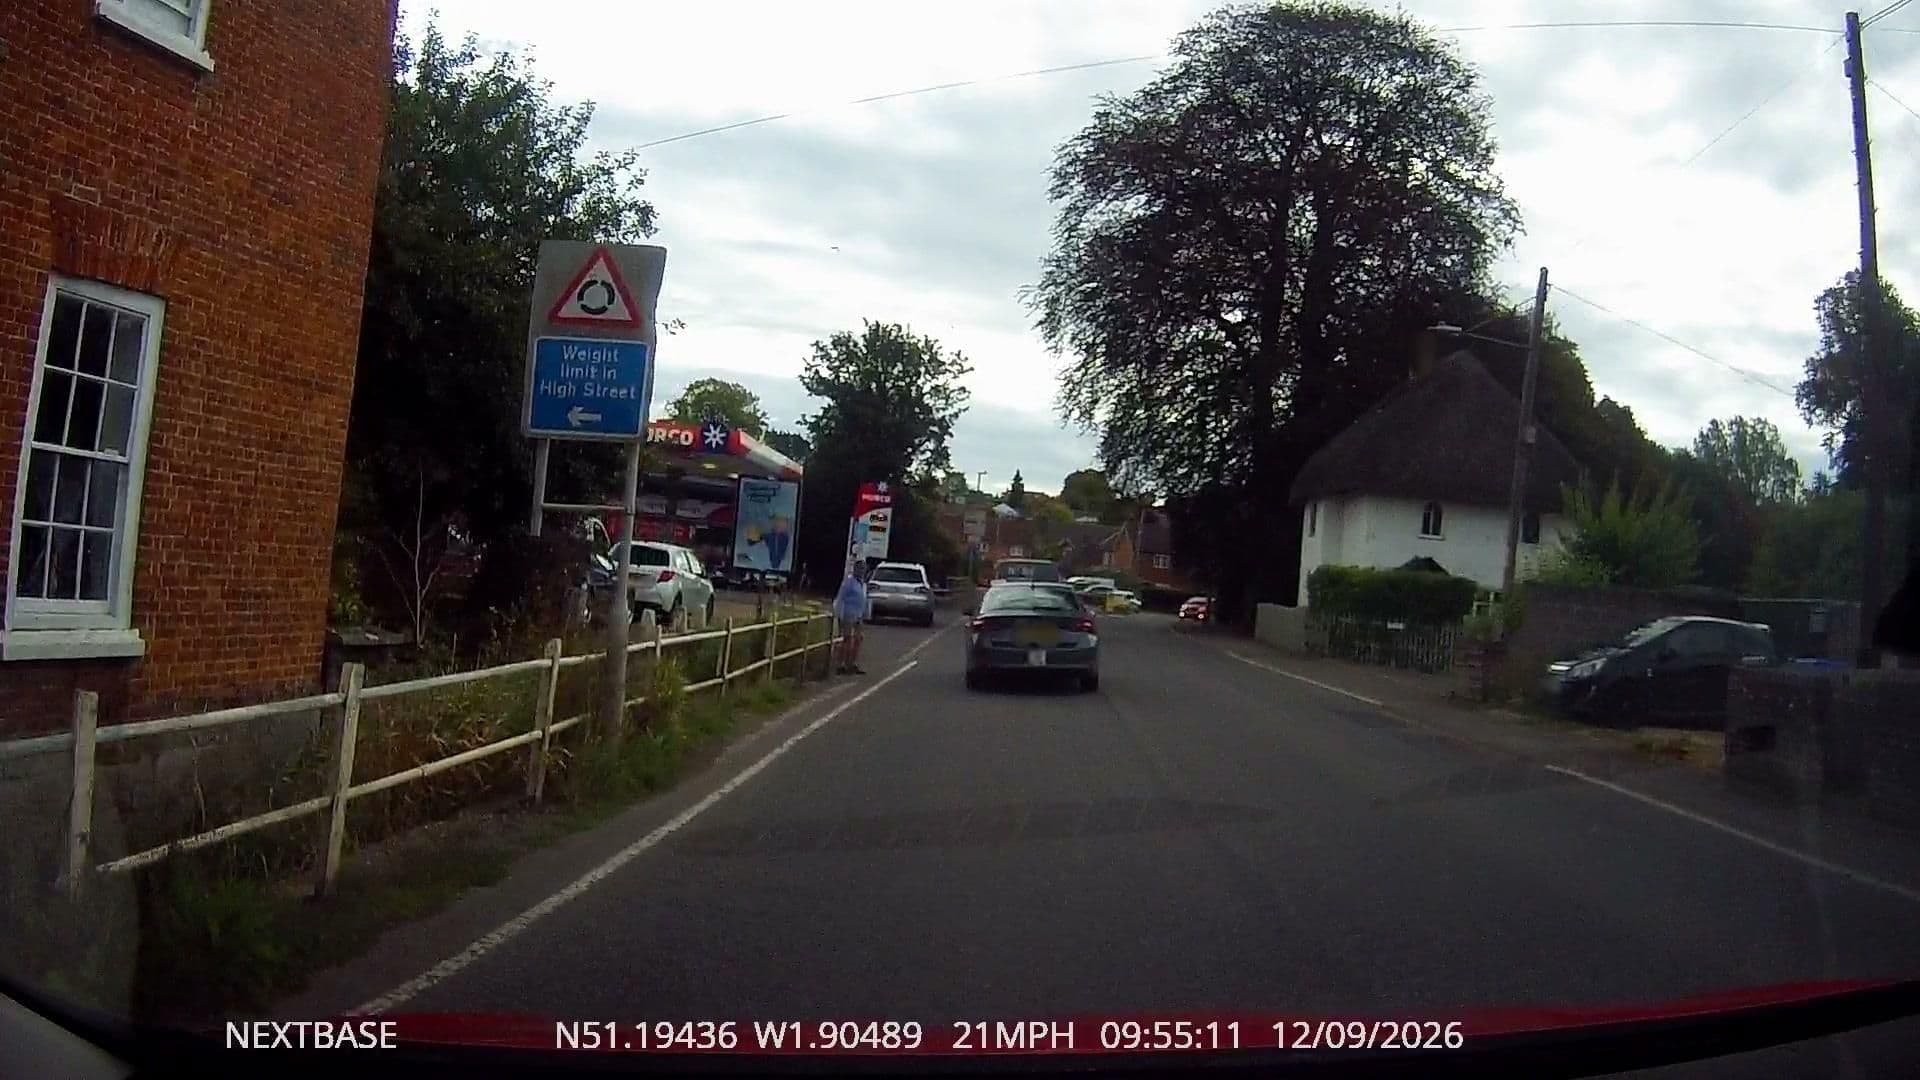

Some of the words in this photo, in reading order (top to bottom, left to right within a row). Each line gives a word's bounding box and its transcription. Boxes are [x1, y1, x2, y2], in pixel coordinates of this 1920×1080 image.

[562, 344, 619, 363] Weight
[560, 363, 596, 379] limit
[602, 364, 617, 380] in
[540, 378, 576, 399] High
[583, 381, 636, 400] Street
